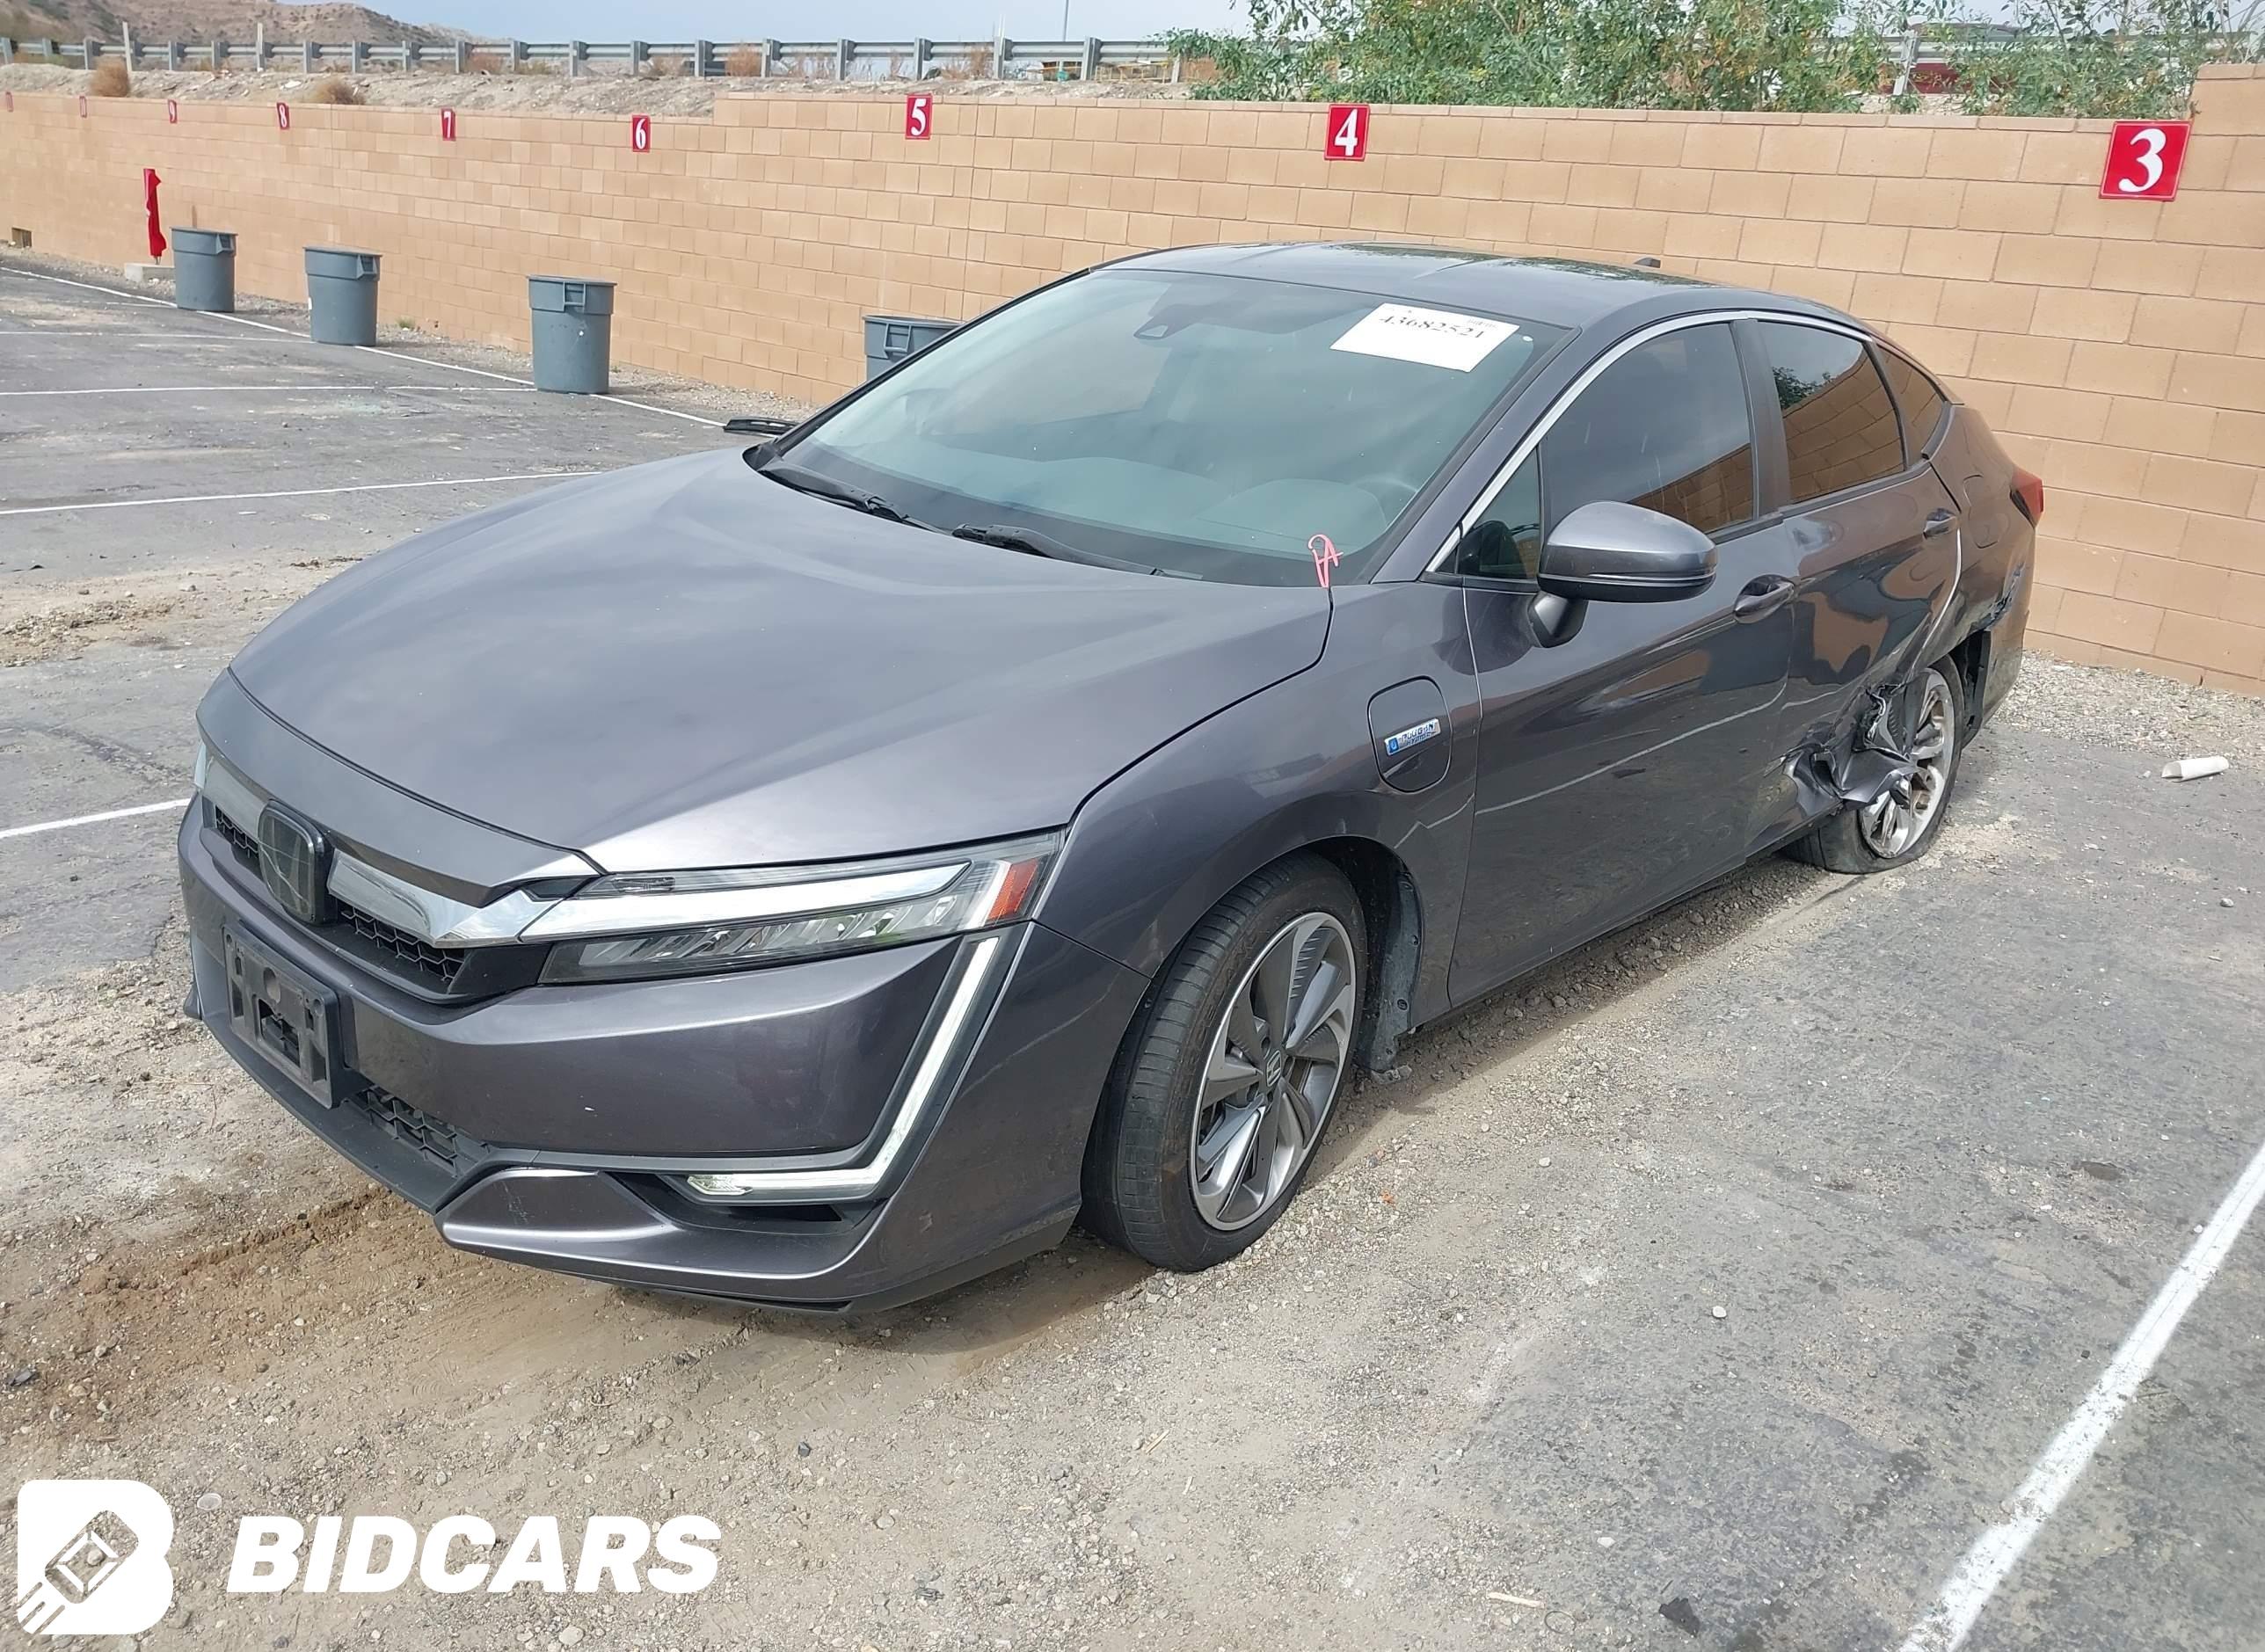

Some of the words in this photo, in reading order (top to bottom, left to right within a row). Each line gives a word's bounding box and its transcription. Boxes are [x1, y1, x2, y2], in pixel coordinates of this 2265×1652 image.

[279, 105, 287, 127] 8
[443, 111, 451, 138] 7
[910, 98, 926, 135] 5
[635, 118, 646, 149] 6
[1334, 108, 1358, 156] 4
[2118, 127, 2167, 193] 3
[1378, 315, 1484, 338] 43682521
